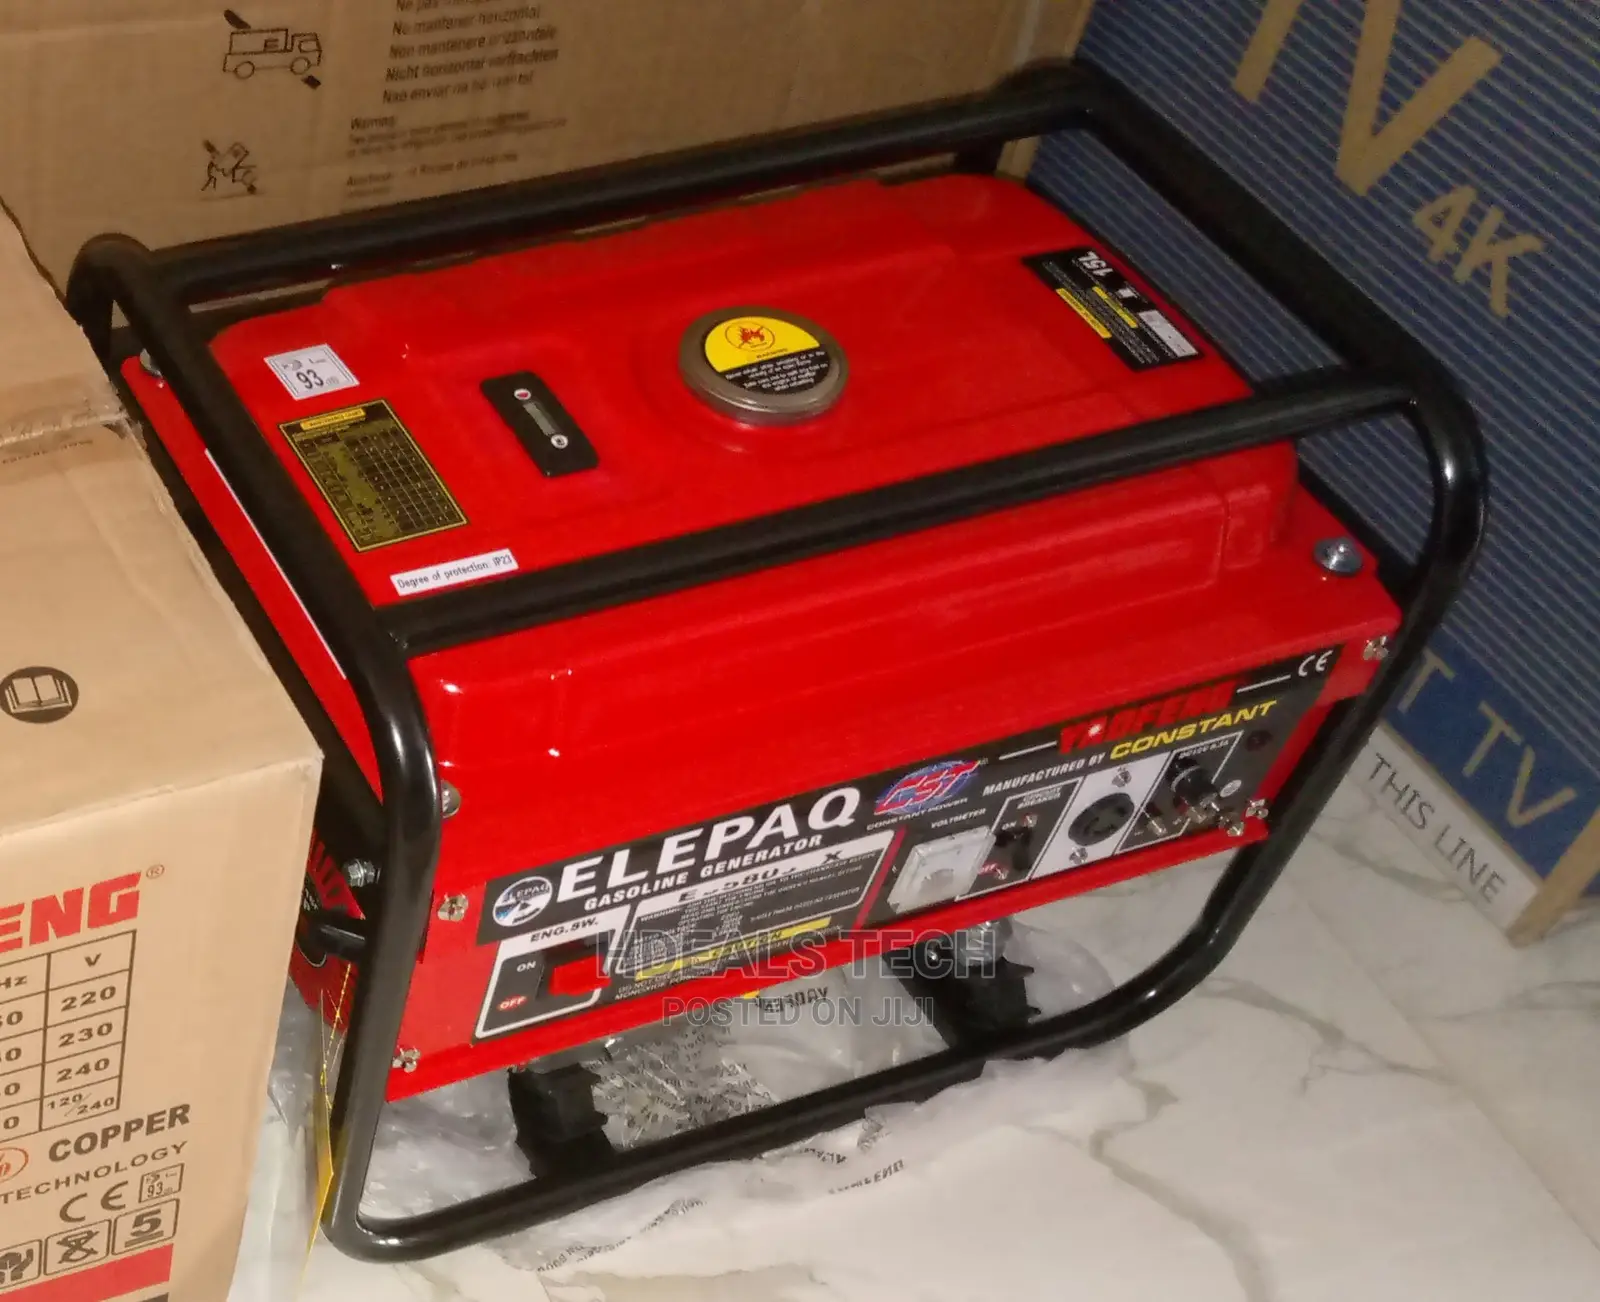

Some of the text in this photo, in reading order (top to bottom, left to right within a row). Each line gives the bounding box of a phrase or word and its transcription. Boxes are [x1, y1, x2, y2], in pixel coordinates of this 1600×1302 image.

[1413, 185, 1545, 318] 4K
[295, 368, 325, 390] 93
[397, 570, 430, 590] Degree
[432, 569, 442, 581] of
[982, 700, 1278, 797] MANUFACTURED BY CONSTANT
[1462, 700, 1578, 827] TV
[1367, 752, 1506, 904] THIS LINE
[557, 786, 861, 904] ELEPAQ
[584, 871, 689, 913] GASOLINE
[699, 833, 824, 879] GENERATOR
[85, 952, 102, 968] V
[516, 961, 536, 973] ON
[61, 986, 117, 1012] 220
[499, 996, 528, 1010] OFF
[58, 1022, 114, 1048] 230
[56, 1057, 111, 1083] 240
[48, 1103, 191, 1163] COPPER
[0, 1140, 188, 1204] TECHNOLOGY
[59, 1180, 129, 1223] CE
[147, 1181, 163, 1198] 93
[130, 1208, 162, 1236] 5
